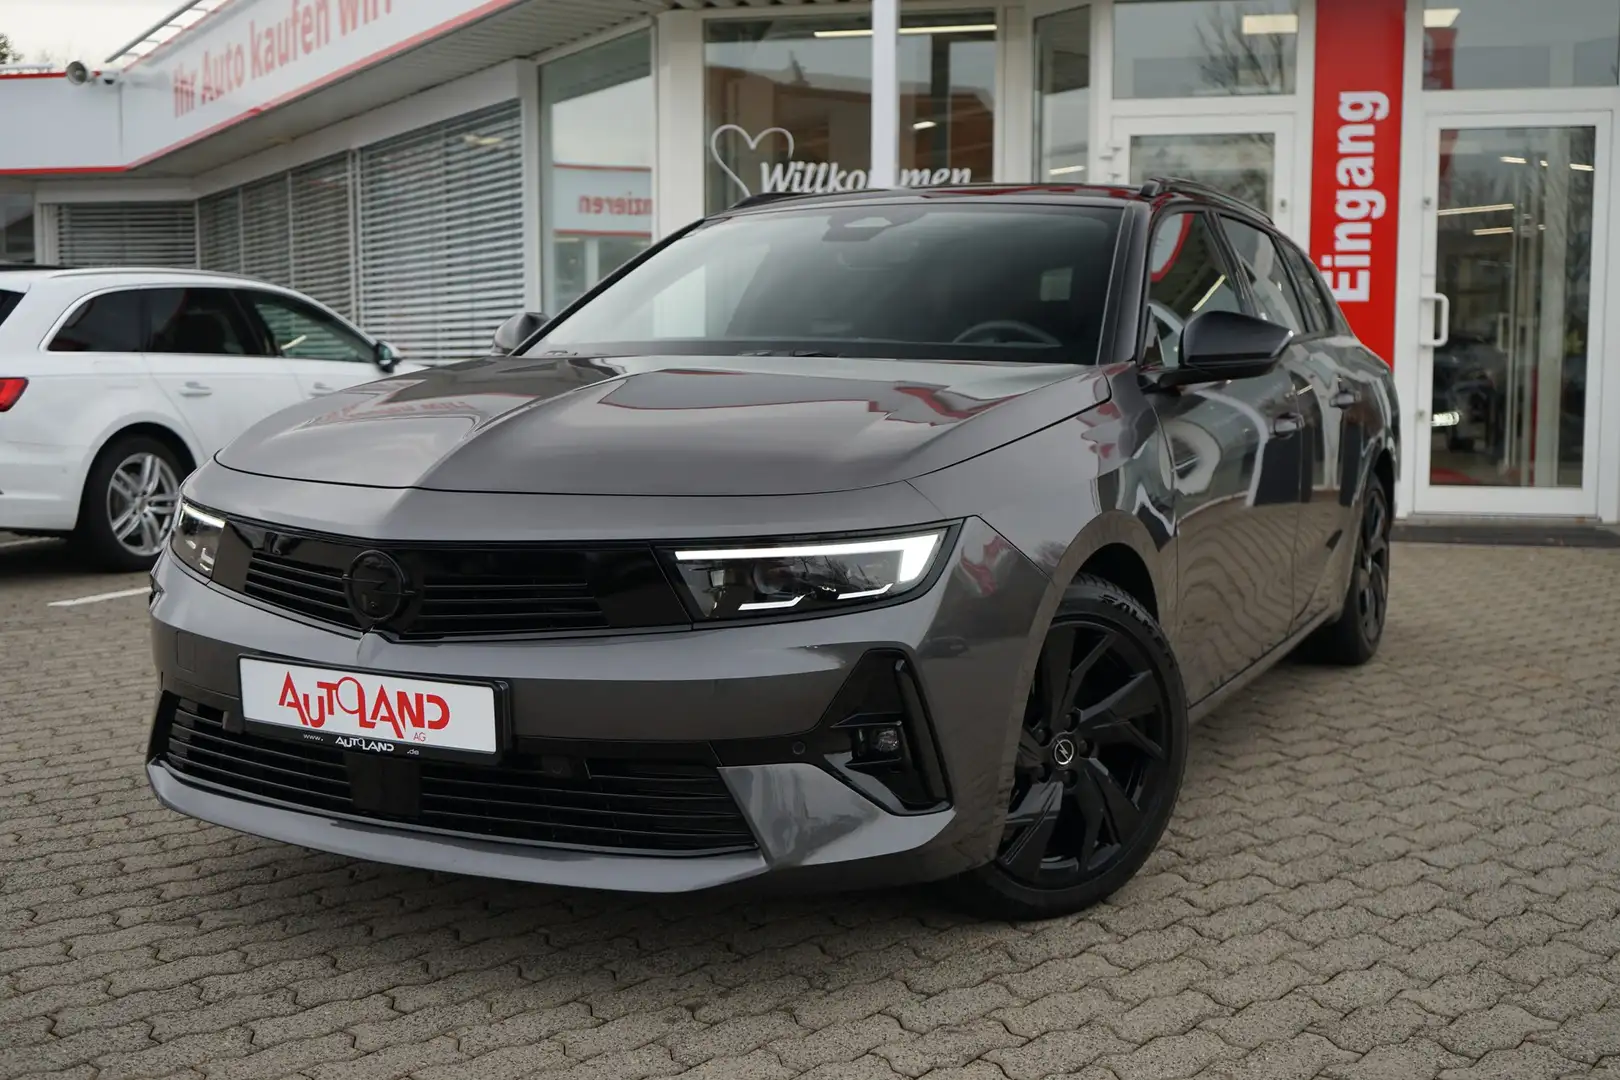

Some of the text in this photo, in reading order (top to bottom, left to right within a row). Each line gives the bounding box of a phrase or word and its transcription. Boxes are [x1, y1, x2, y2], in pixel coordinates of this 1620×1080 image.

[173, 62, 197, 118] Ihr
[202, 43, 245, 105] Auto
[250, 0, 330, 80] kaufen
[760, 160, 972, 194] Willkomen
[1321, 90, 1390, 303] Eingang
[413, 731, 427, 742] AG
